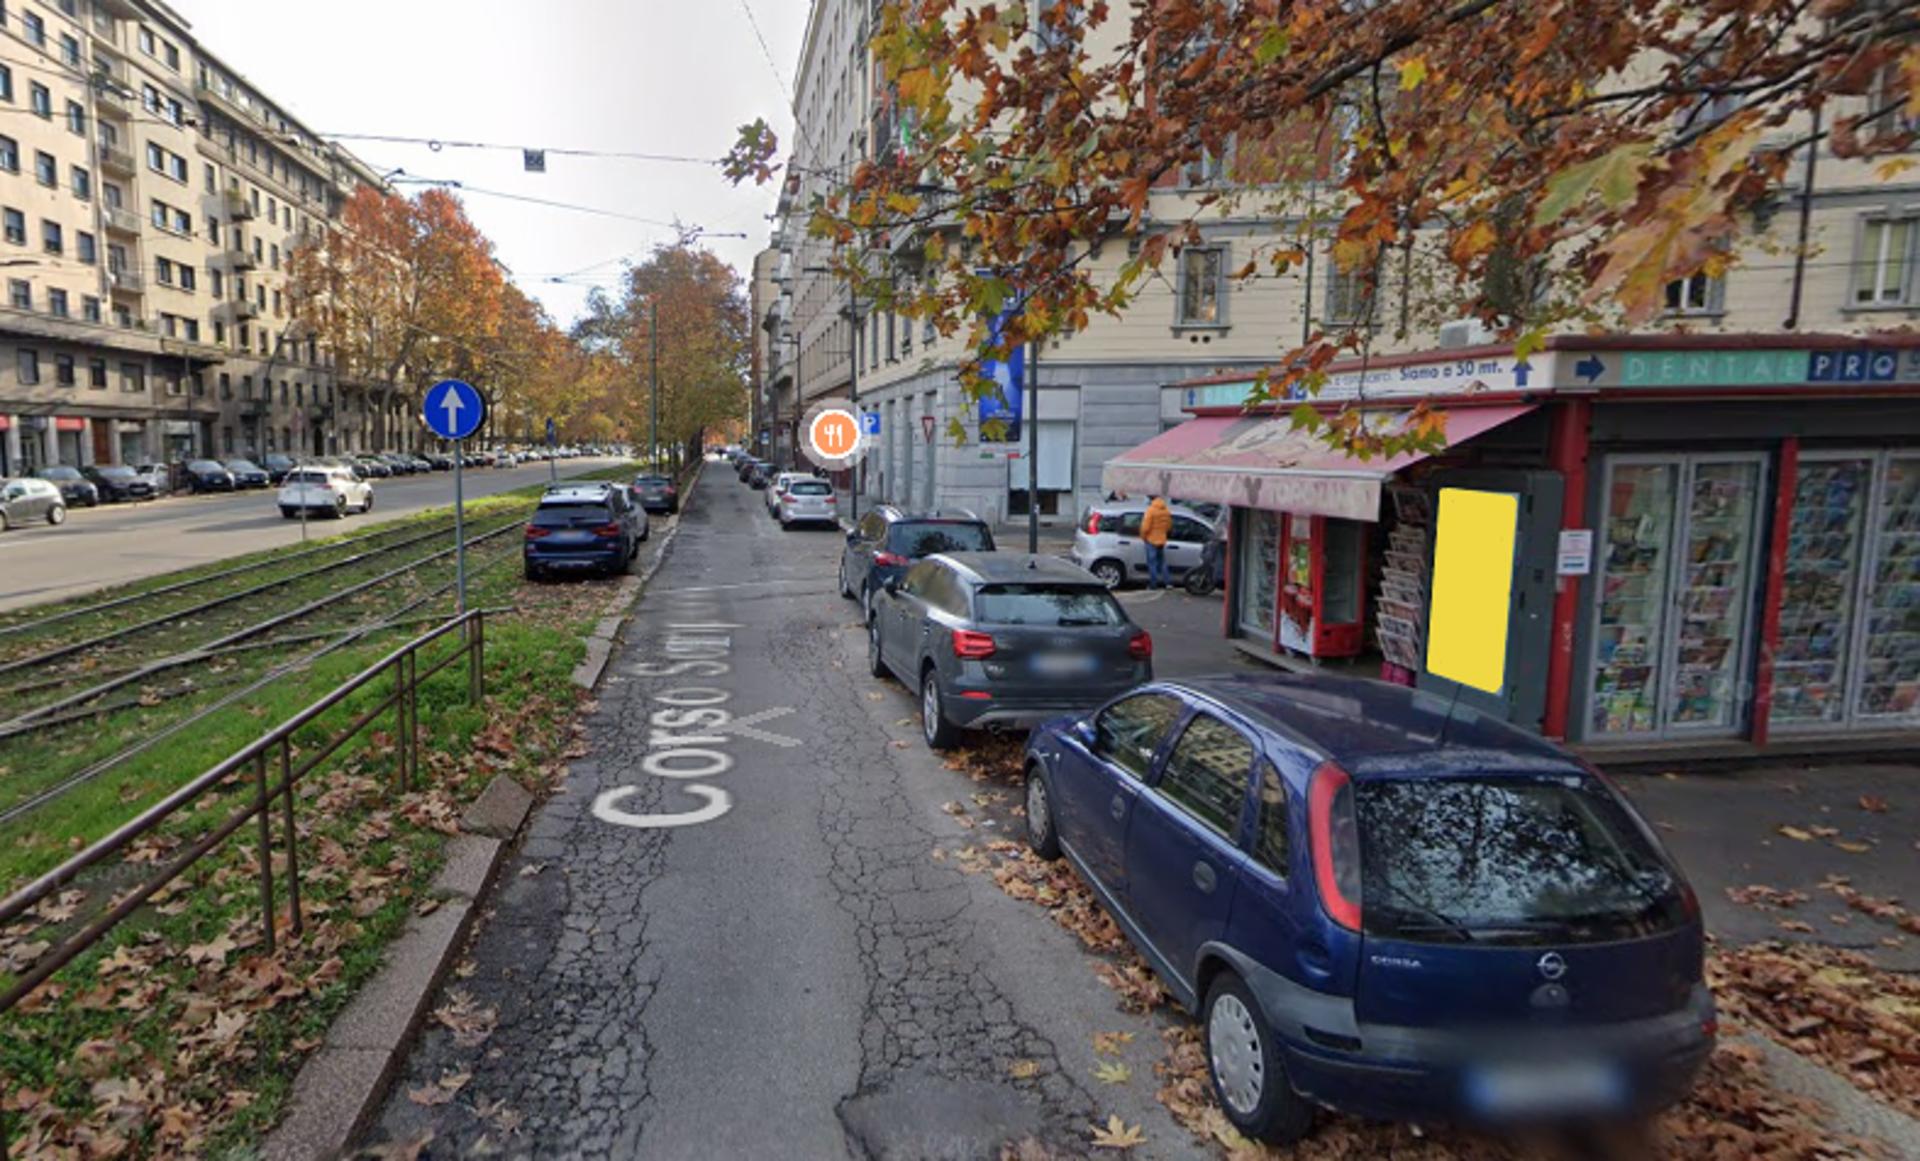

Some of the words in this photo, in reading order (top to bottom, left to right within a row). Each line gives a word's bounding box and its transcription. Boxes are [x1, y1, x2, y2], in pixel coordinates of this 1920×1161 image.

[1400, 367, 1439, 382] Siamo
[1456, 359, 1475, 377] 50
[1628, 356, 1801, 380] DENTAL
[1813, 355, 1895, 376] PRO
